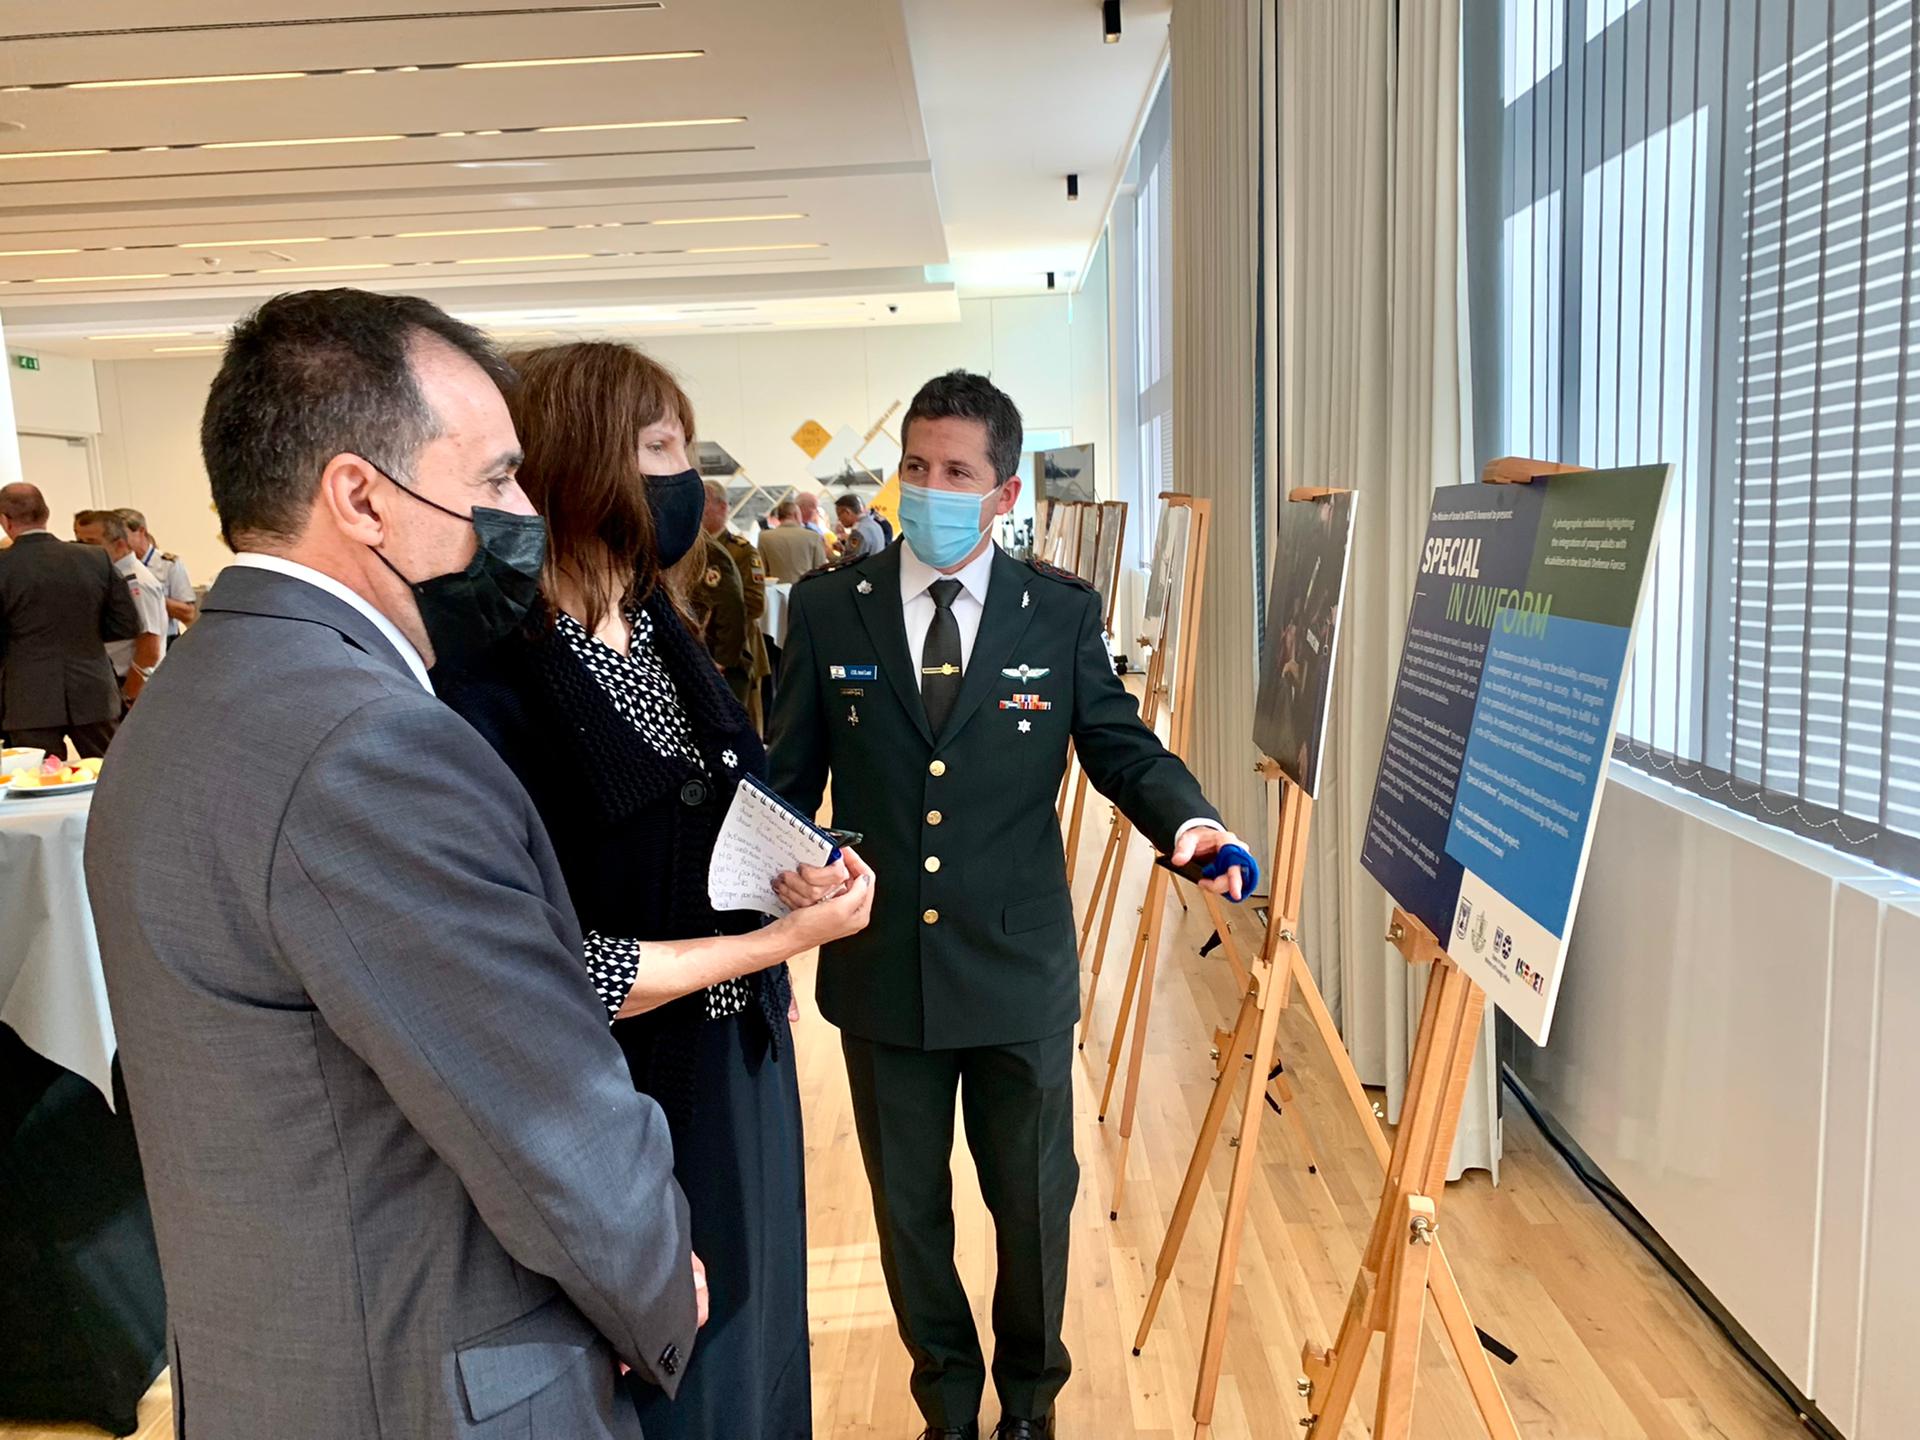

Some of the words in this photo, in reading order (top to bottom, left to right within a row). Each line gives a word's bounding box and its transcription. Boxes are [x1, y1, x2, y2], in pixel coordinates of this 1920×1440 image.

[1421, 537, 1481, 578] SPECIAL
[1445, 582, 1466, 622] IN
[1464, 584, 1553, 641] UNIFORM
